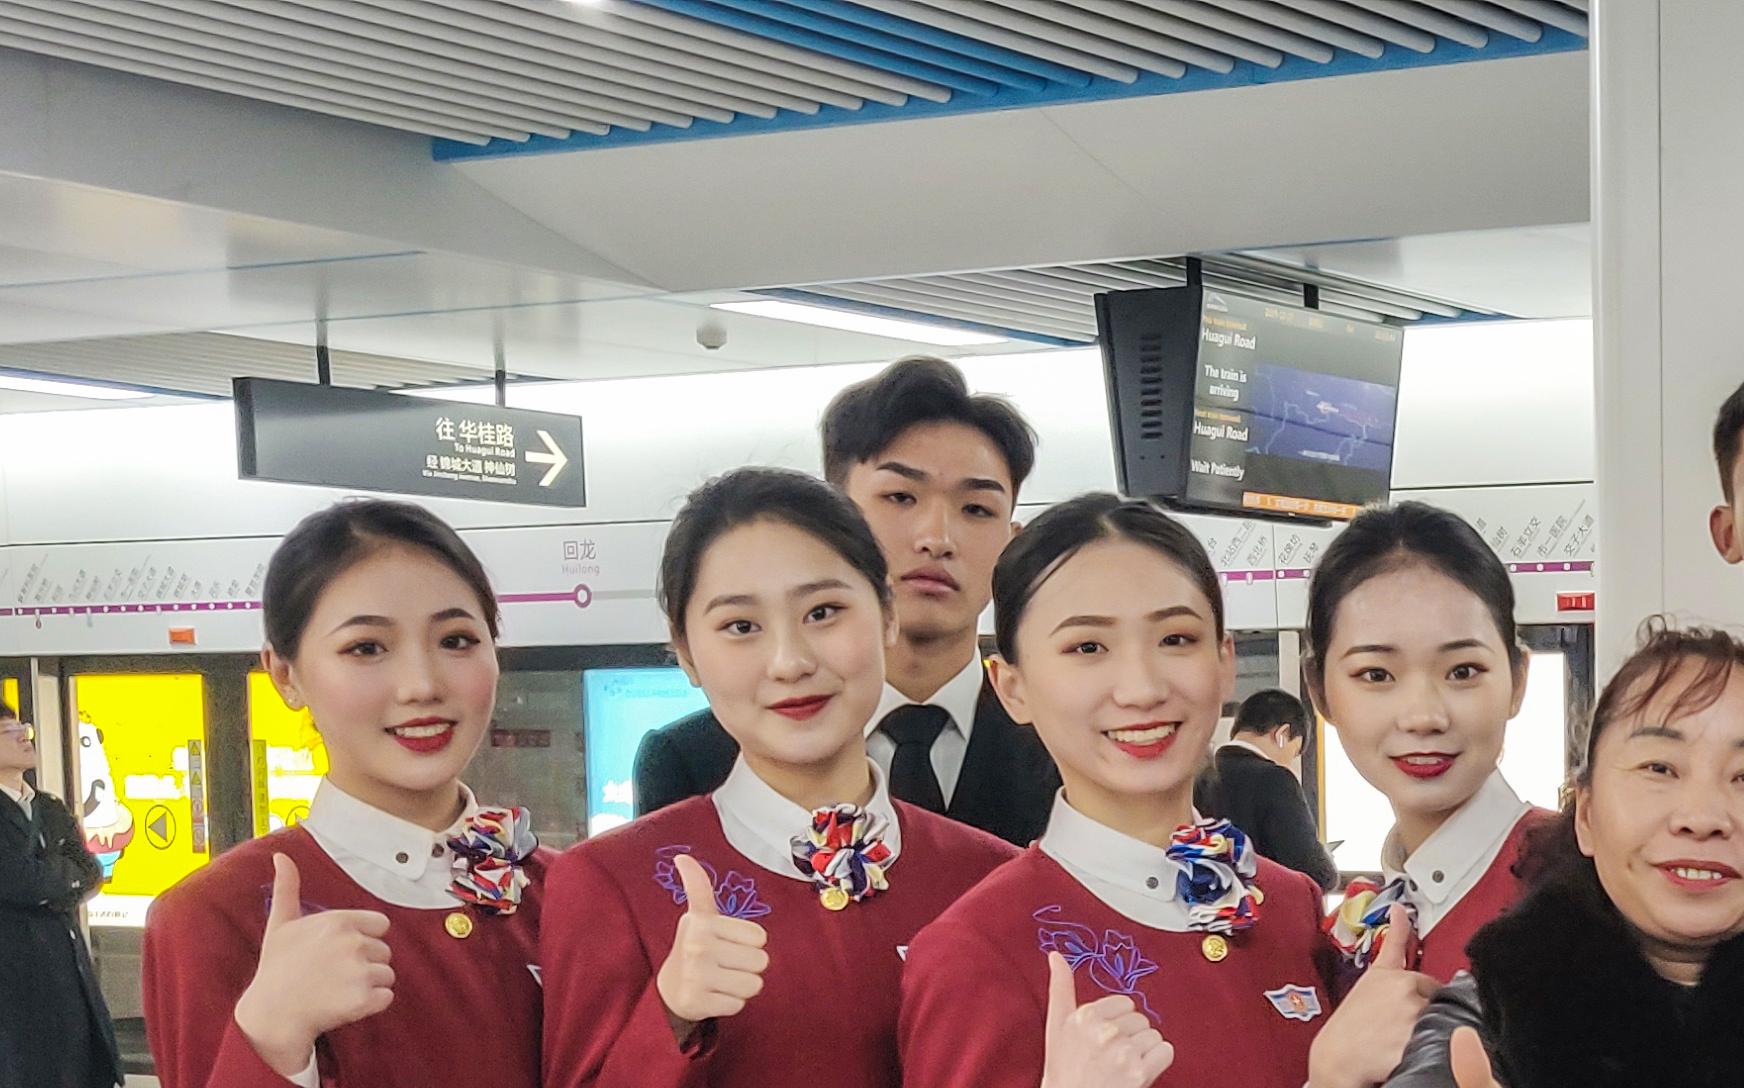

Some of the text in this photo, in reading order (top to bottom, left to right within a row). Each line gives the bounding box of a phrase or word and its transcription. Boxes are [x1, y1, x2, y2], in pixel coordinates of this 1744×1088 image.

[1202, 328, 1256, 350] Huagui Road
[1204, 364, 1247, 382] The train is
[1209, 384, 1239, 402] arriving
[435, 416, 515, 447] 往 华桂路
[1193, 421, 1249, 441] Huagui Road
[454, 442, 516, 458] To Huagui Road
[1191, 459, 1245, 480] Wait Patiently
[563, 539, 597, 561] 回龙
[561, 564, 600, 576] Huilong
